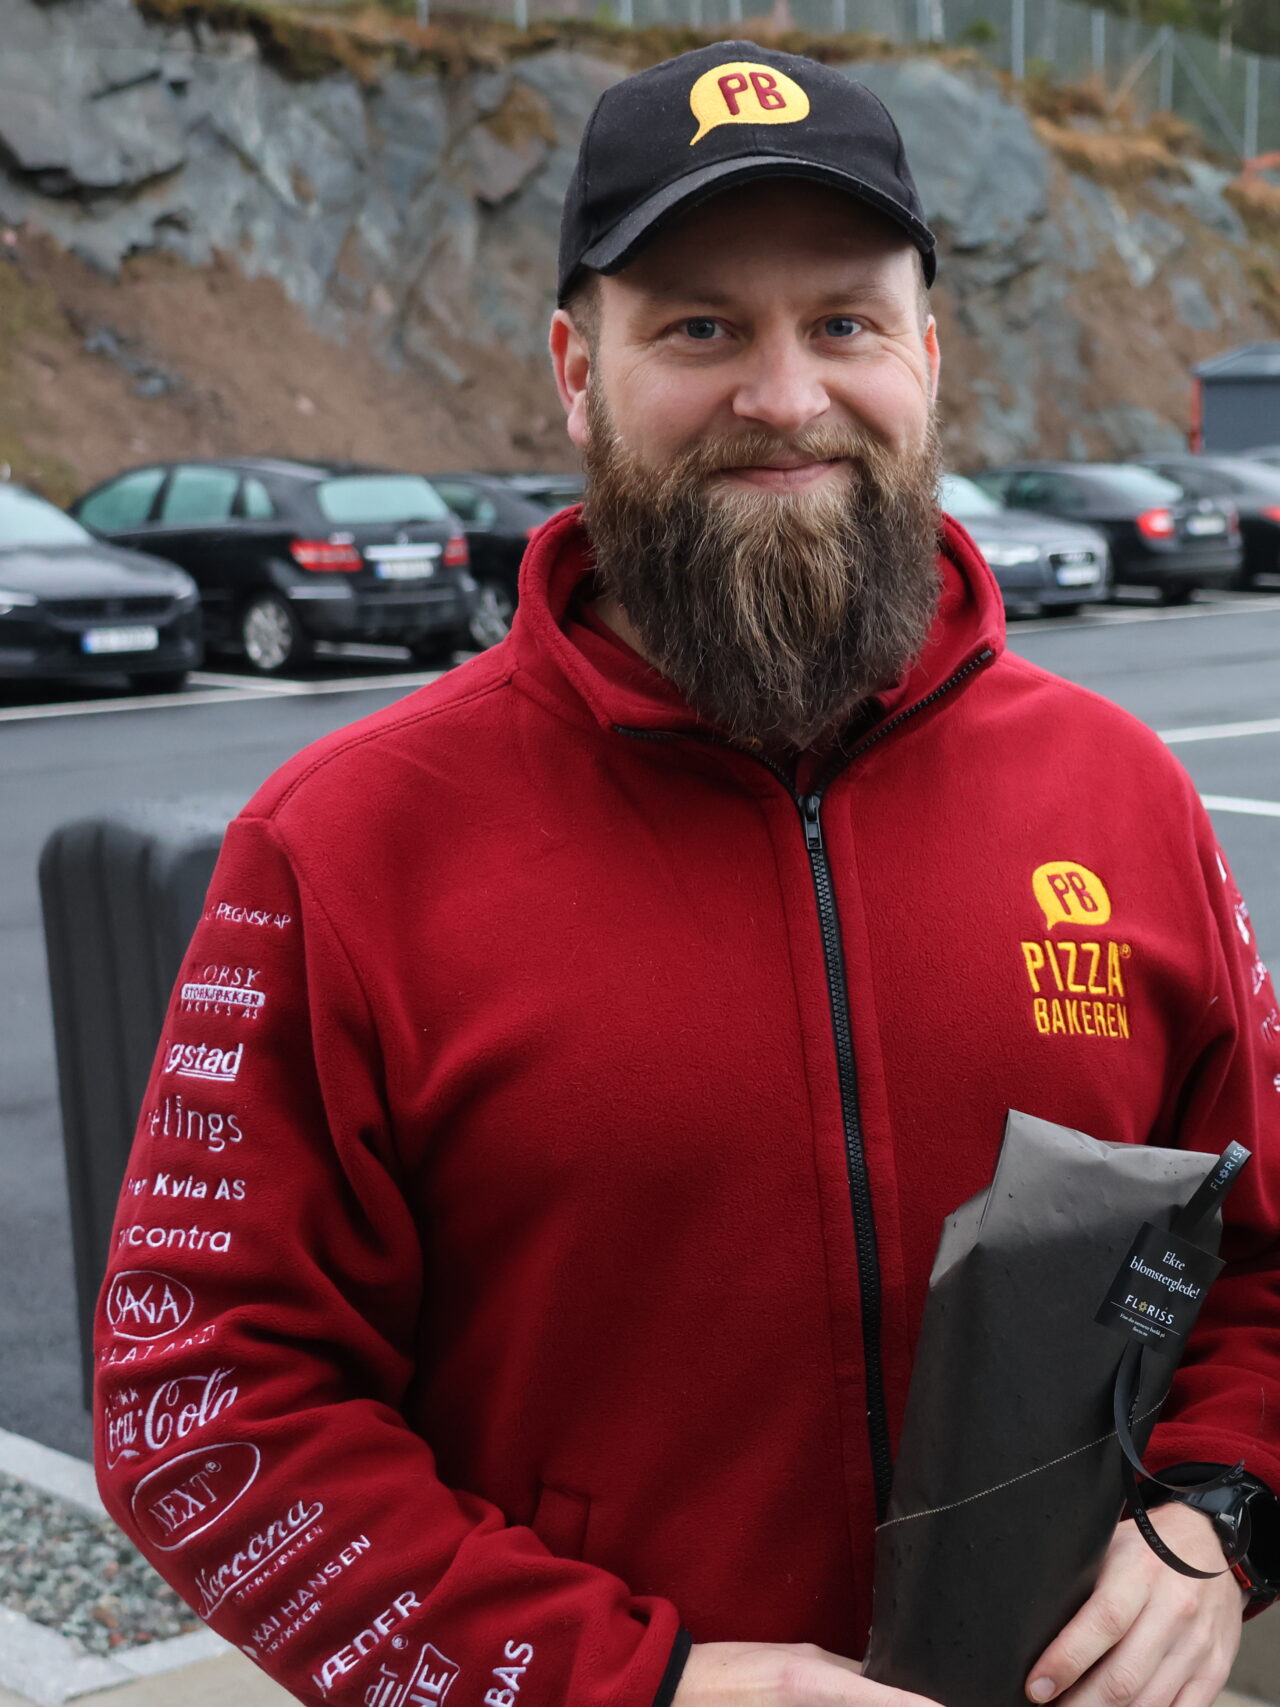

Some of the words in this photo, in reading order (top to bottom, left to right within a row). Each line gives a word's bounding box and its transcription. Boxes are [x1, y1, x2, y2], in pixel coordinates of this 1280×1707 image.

[717, 71, 787, 116] PB
[1046, 871, 1099, 916] PB
[202, 964, 262, 988] ORSK
[1020, 940, 1125, 998] PIZZA
[1033, 997, 1130, 1040] BAKEREN
[163, 1042, 245, 1076] gstad
[151, 1172, 208, 1199] Kvia
[214, 1177, 247, 1201] AS
[1129, 1256, 1201, 1300] blomsterglede!
[1162, 1250, 1186, 1272] Ekte
[112, 1283, 181, 1325] SAGA
[1124, 1294, 1175, 1326] FLORISS
[232, 1524, 324, 1604] TORKJØKKEN
[252, 1615, 281, 1649] KAI
[280, 1533, 373, 1618] HANSEN
[311, 1590, 422, 1699] ÆDER
